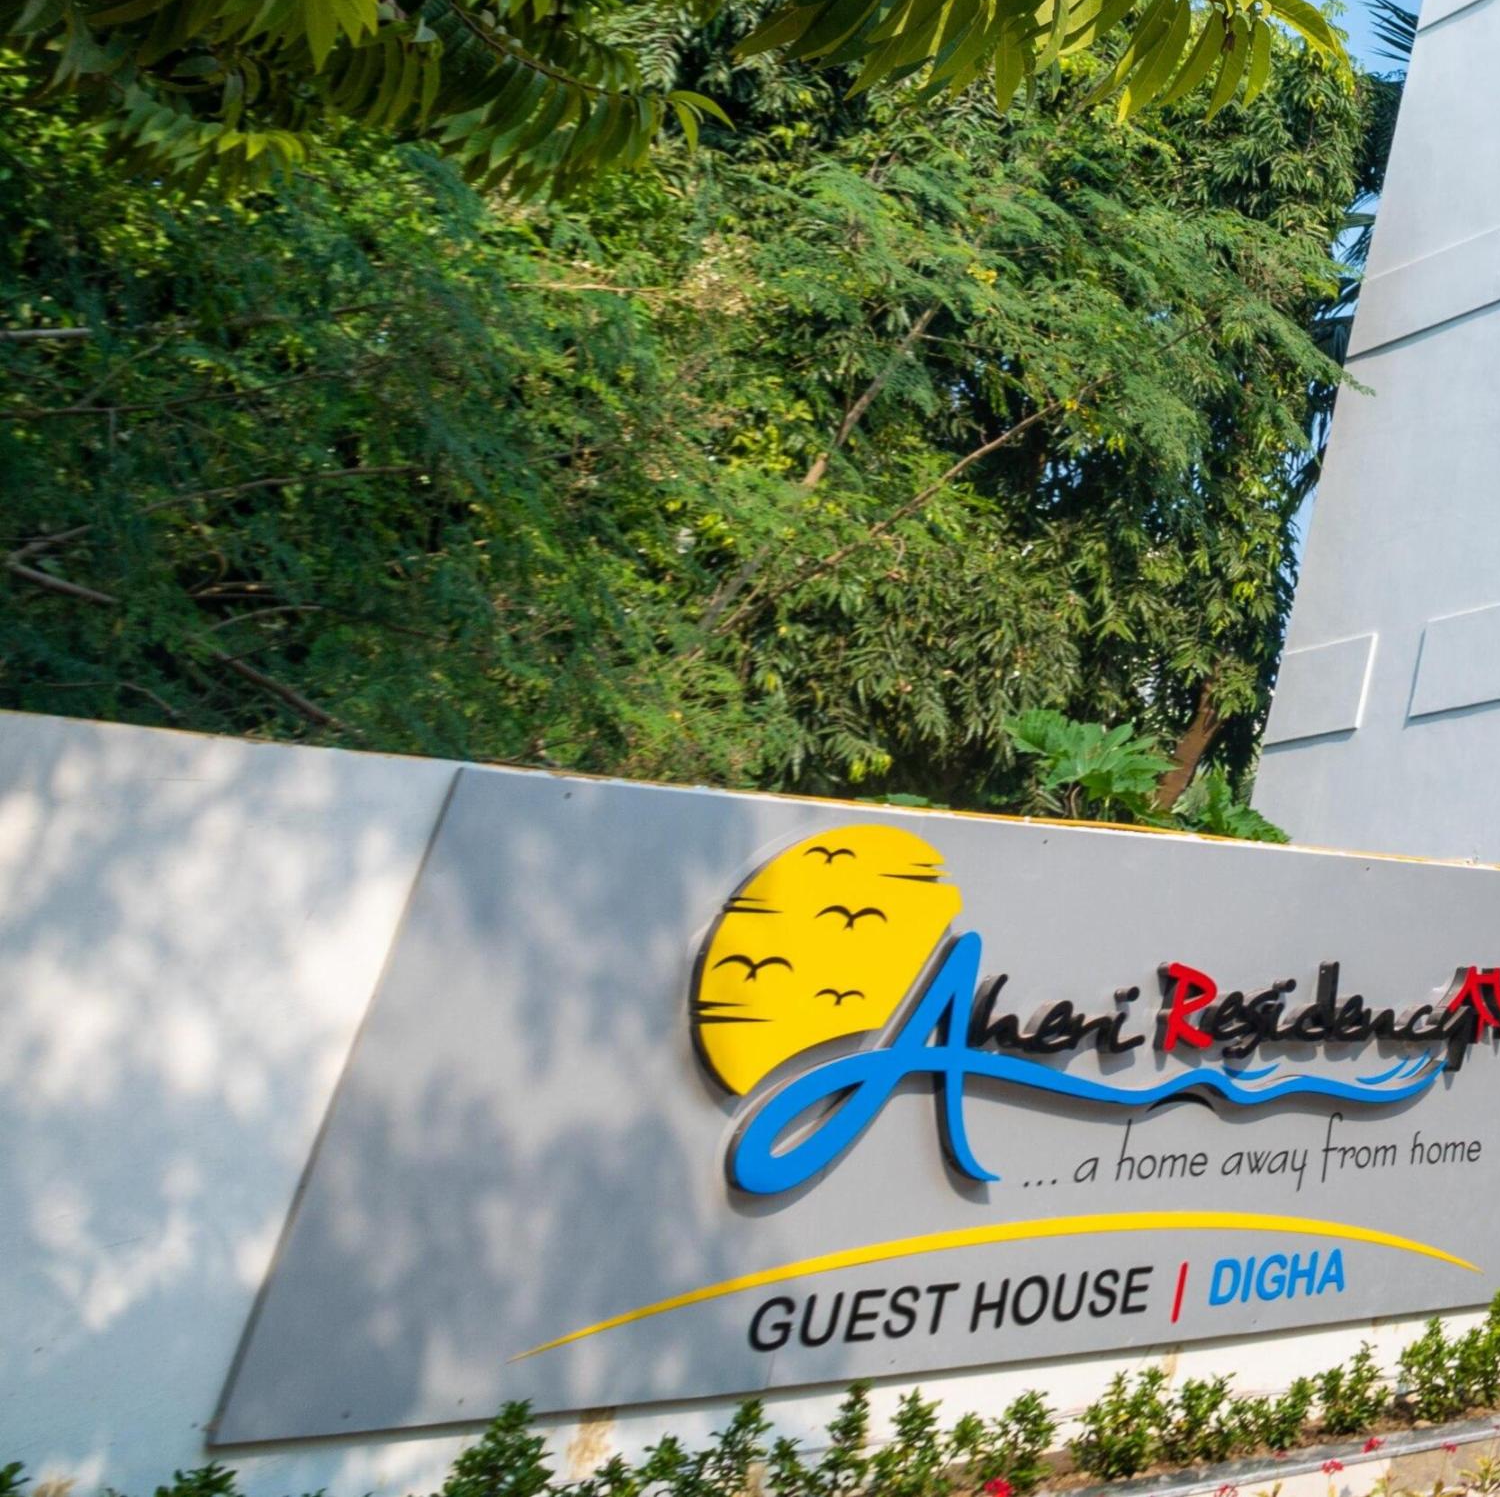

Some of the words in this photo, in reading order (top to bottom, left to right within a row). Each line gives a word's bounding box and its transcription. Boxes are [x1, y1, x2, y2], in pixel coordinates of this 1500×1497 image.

[1157, 961, 1487, 1073] Residency
[1073, 1156, 1099, 1183] a
[1115, 1119, 1209, 1182] home
[1220, 1142, 1309, 1191] away
[1321, 1112, 1397, 1183] from
[1409, 1131, 1483, 1166] home
[747, 1282, 960, 1353] GUEST
[968, 1265, 1155, 1332] HOUSE
[1207, 1248, 1346, 1307] DIGHA
